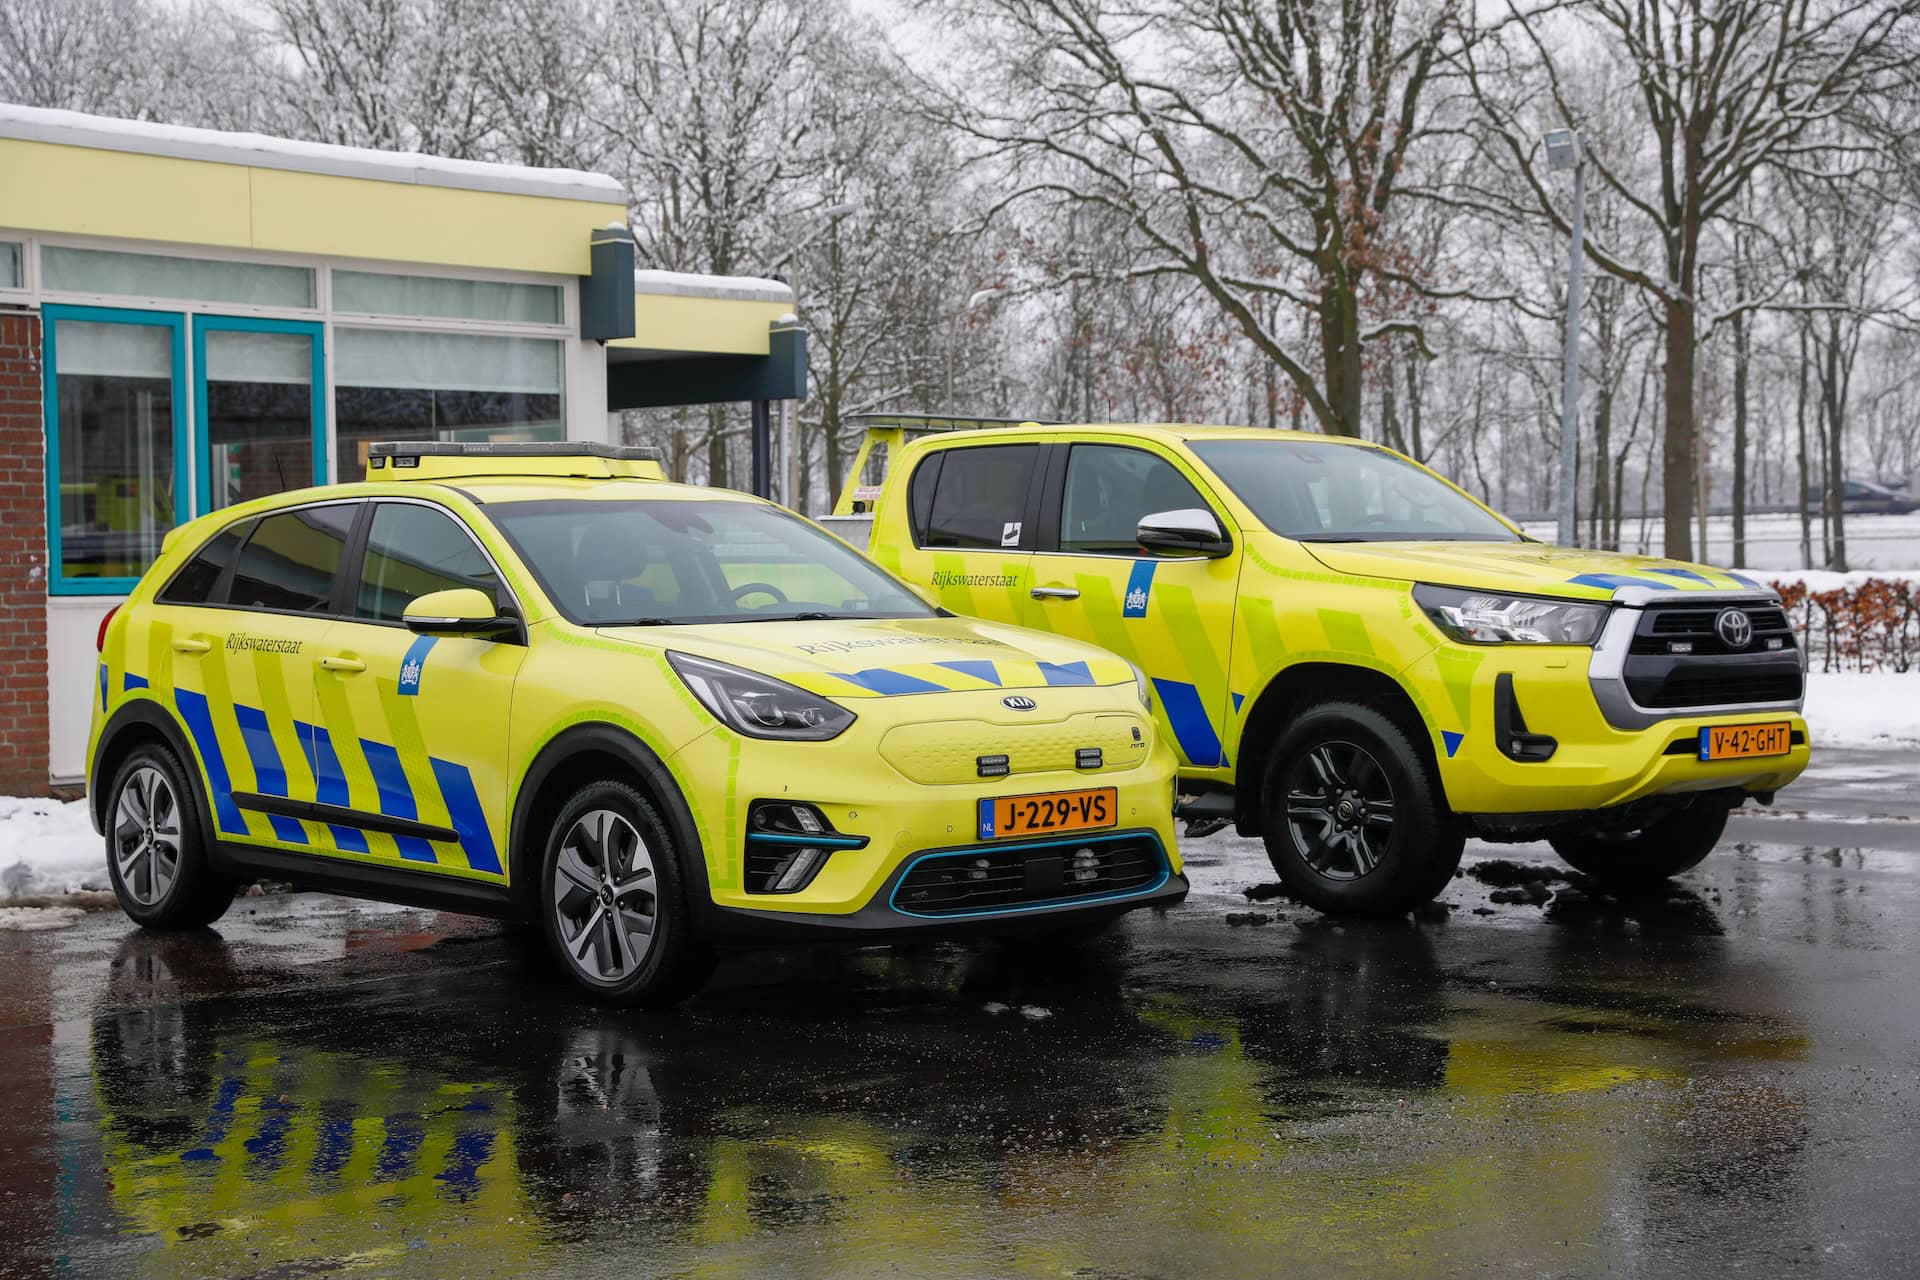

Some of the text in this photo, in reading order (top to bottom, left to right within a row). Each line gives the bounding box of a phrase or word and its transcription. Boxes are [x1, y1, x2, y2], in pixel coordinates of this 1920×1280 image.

[931, 571, 1018, 591] Rijkswaterstaat
[225, 632, 303, 655] Rijkswaterstaat
[1006, 697, 1034, 707] KIA
[1715, 727, 1785, 754] V-42-GHT
[1004, 795, 1107, 831] J-229-VS
[982, 822, 993, 832] NL
